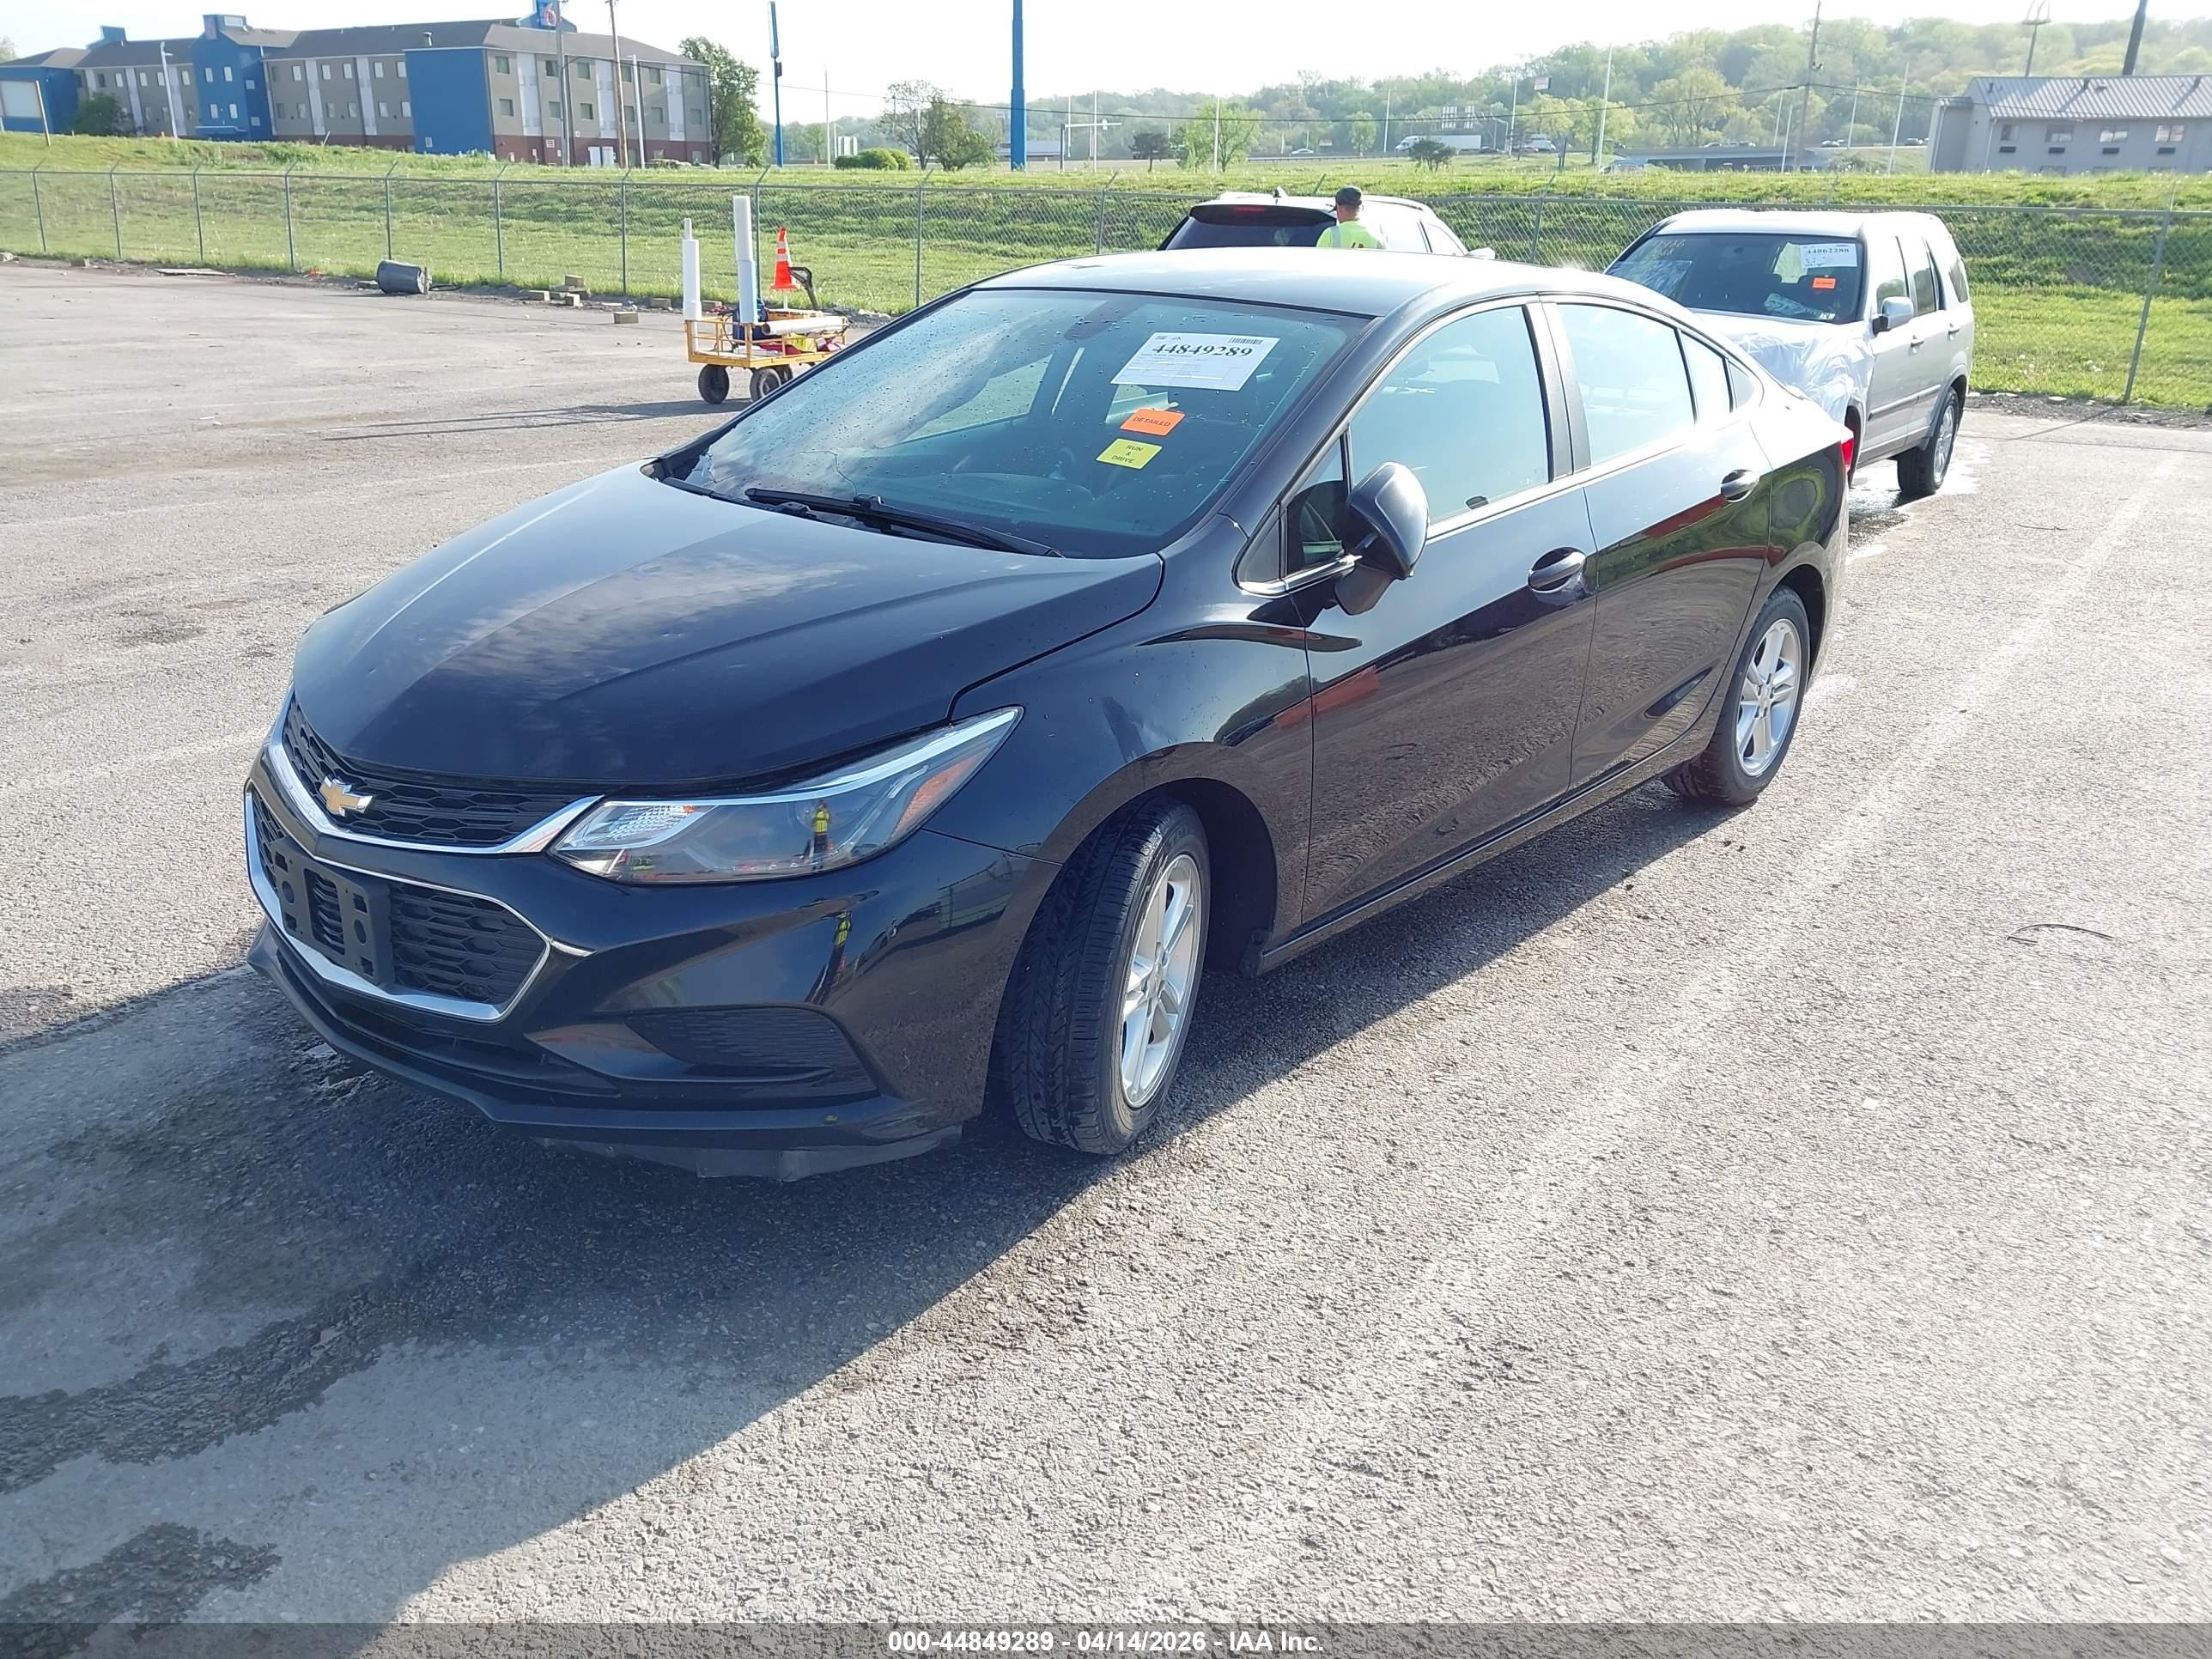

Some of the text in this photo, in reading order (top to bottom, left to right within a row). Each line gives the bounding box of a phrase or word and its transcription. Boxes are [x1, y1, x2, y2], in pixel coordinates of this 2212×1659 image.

[1152, 343, 1253, 357] 44849289
[1133, 416, 1171, 427] DETAILED
[1111, 455, 1135, 464] DRIVE
